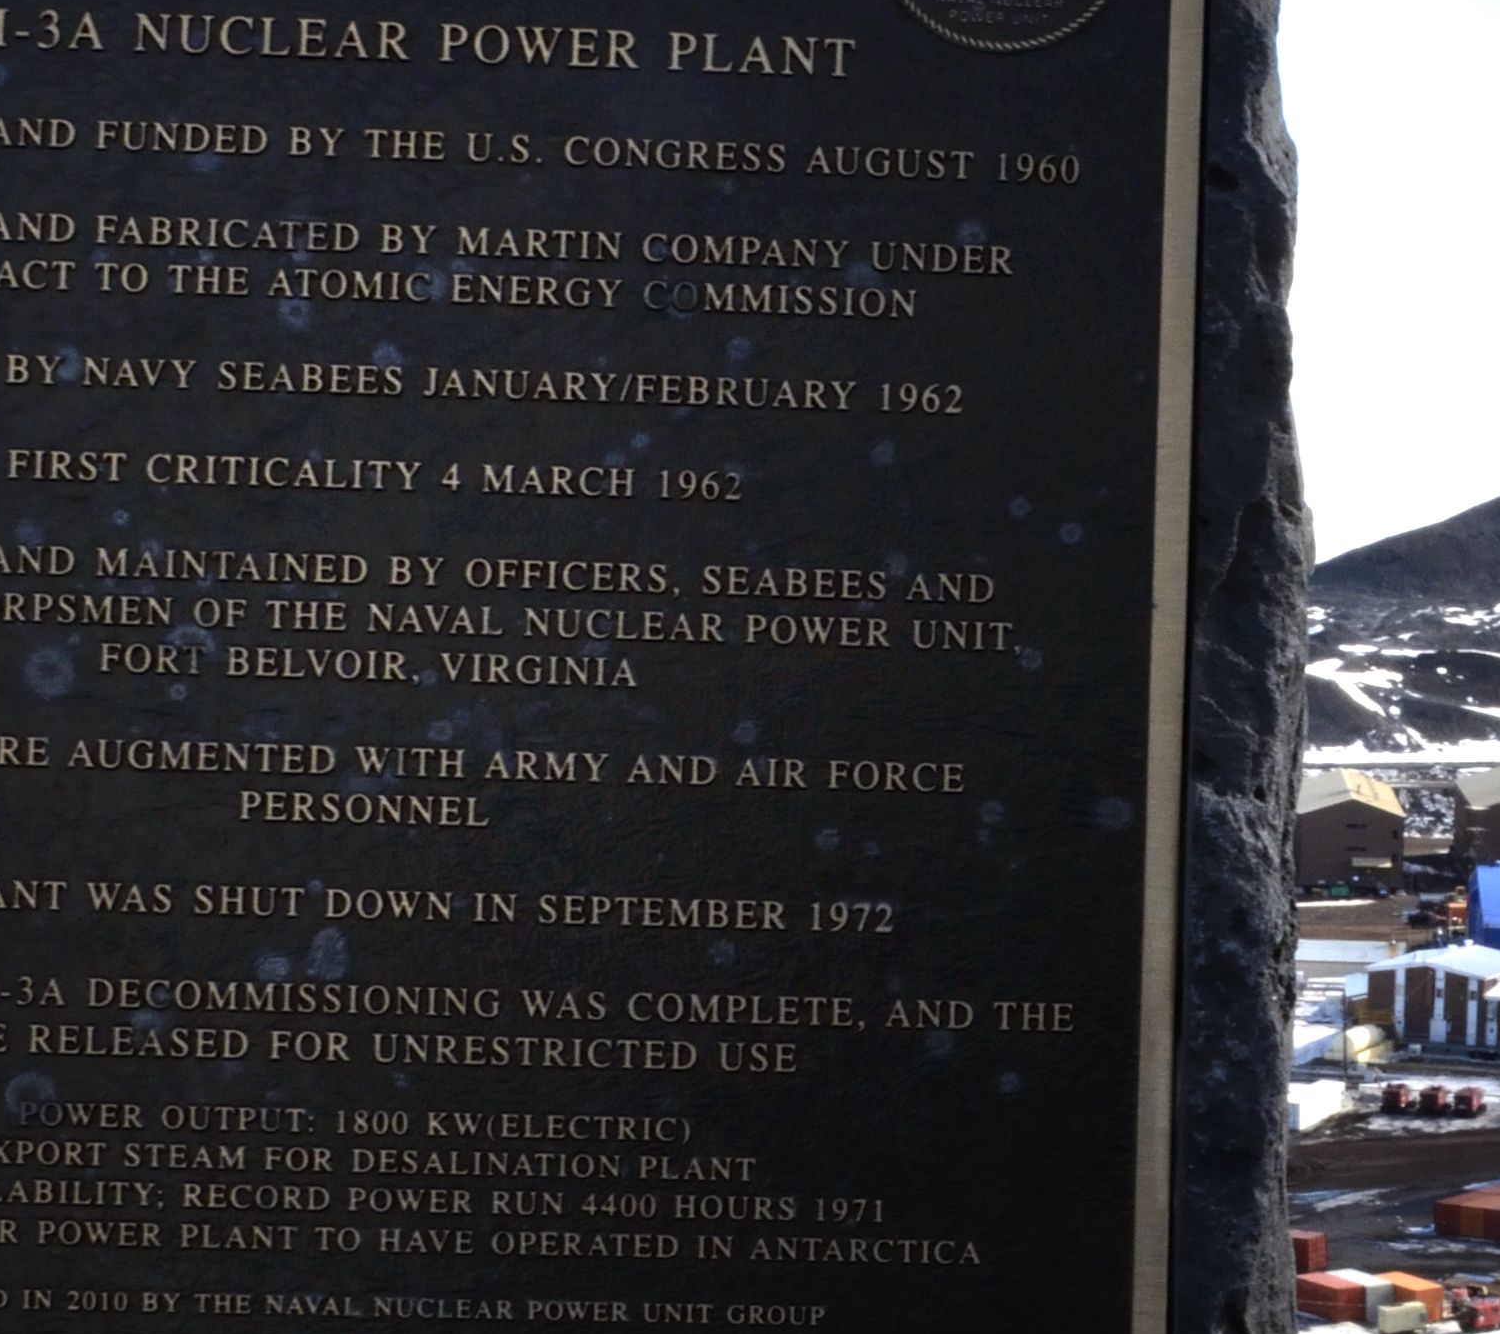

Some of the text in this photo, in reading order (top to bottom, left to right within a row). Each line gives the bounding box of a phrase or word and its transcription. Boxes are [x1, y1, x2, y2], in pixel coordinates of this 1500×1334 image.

[135, 13, 408, 59] NUCLEAR
[441, 24, 638, 68] POWER
[669, 32, 855, 76] PLANT
[97, 121, 267, 153] FUNDED
[290, 127, 343, 155] BY
[365, 129, 444, 159] THE
[467, 133, 541, 162] U.S.
[565, 136, 785, 171] CONGRESS
[807, 146, 974, 178] AUGUST
[999, 153, 1079, 183] 1960
[97, 215, 359, 250] FABRICATED
[381, 224, 435, 253] BY
[459, 227, 621, 258] MARTIN
[643, 233, 848, 267] COMPANY
[873, 242, 1012, 274] UNDER
[95, 263, 147, 291] TO
[169, 265, 247, 294] THE
[269, 269, 429, 300] ATOMIC
[453, 274, 621, 306] ENERGY
[644, 281, 916, 317] COMMISSION
[7, 355, 60, 383] BY
[84, 357, 196, 388] NAVY
[218, 361, 404, 395] SEABEES
[424, 368, 855, 409] JANUARY/FEBRUARY
[882, 383, 962, 413] 1962
[8, 450, 740, 499] FIRST CRITICALITY 4 MARCH 1962
[97, 548, 367, 583] MAINTAINED
[391, 556, 443, 585] BY
[466, 558, 679, 595] OFFICERS,
[703, 565, 885, 598] SEABEES
[907, 573, 993, 602] AND
[192, 598, 246, 631] OF
[266, 601, 345, 630] THE
[368, 604, 502, 634] NAVAL
[525, 608, 723, 641] NUCLEAR
[747, 615, 889, 646] POWER
[914, 620, 1020, 654] UNIT,
[101, 644, 636, 686] FORT BELVOIR, VIRGINIA
[68, 739, 335, 773] AUGMENTED
[356, 747, 464, 777] WITH
[485, 751, 608, 781] ARMY
[627, 755, 716, 784] AND
[736, 759, 806, 787] AIR
[829, 760, 963, 792] FORCE
[241, 791, 488, 826] PERSONNEL
[87, 883, 171, 912] WAS
[195, 885, 304, 916] SHUT
[326, 889, 452, 919] DOWN
[475, 893, 516, 921] IN
[539, 895, 785, 929] SEPTEMBER
[812, 902, 893, 932] 1972
[89, 978, 499, 1018] DECOMMISSIONING
[522, 990, 605, 1019] WAS
[628, 992, 864, 1030] COMPLETE,
[886, 1000, 973, 1028] AND
[994, 1002, 1072, 1031] THE
[30, 1025, 248, 1057] RELEASED
[271, 1031, 349, 1060] FOR
[374, 1034, 696, 1069] UNRESTRICTED
[720, 1043, 796, 1072] USE
[22, 1103, 690, 1141] POWER OUTPUT: 1800 KW(ELECTRIC)
[125, 1143, 244, 1169] STEAM
[266, 1147, 331, 1171] FOR
[353, 1149, 619, 1177] DESALINATION
[641, 1156, 756, 1181] PLANT
[184, 1184, 329, 1210] RECORD
[349, 1188, 471, 1213] POWER
[493, 1191, 562, 1214] RUN
[582, 1194, 656, 1217] 4400
[676, 1195, 795, 1220] HOURS
[818, 1198, 882, 1222] 1971
[38, 1221, 160, 1246] POWER
[181, 1224, 297, 1249] PLANT
[315, 1227, 361, 1251] TO
[380, 1228, 472, 1253] HAVE
[492, 1232, 678, 1257] OPERATED
[698, 1236, 732, 1259] IN
[750, 1238, 980, 1264] ANTARCTICA
[23, 1290, 51, 1309] IN
[67, 1290, 128, 1311] 2010
[143, 1292, 179, 1312] BY
[194, 1294, 250, 1313] THE
[266, 1295, 361, 1316] NAVAL
[374, 1297, 513, 1319] NUCLEAR
[528, 1300, 628, 1321] POWER
[644, 1303, 713, 1323] UNIT
[727, 1305, 825, 1325] GROUP
